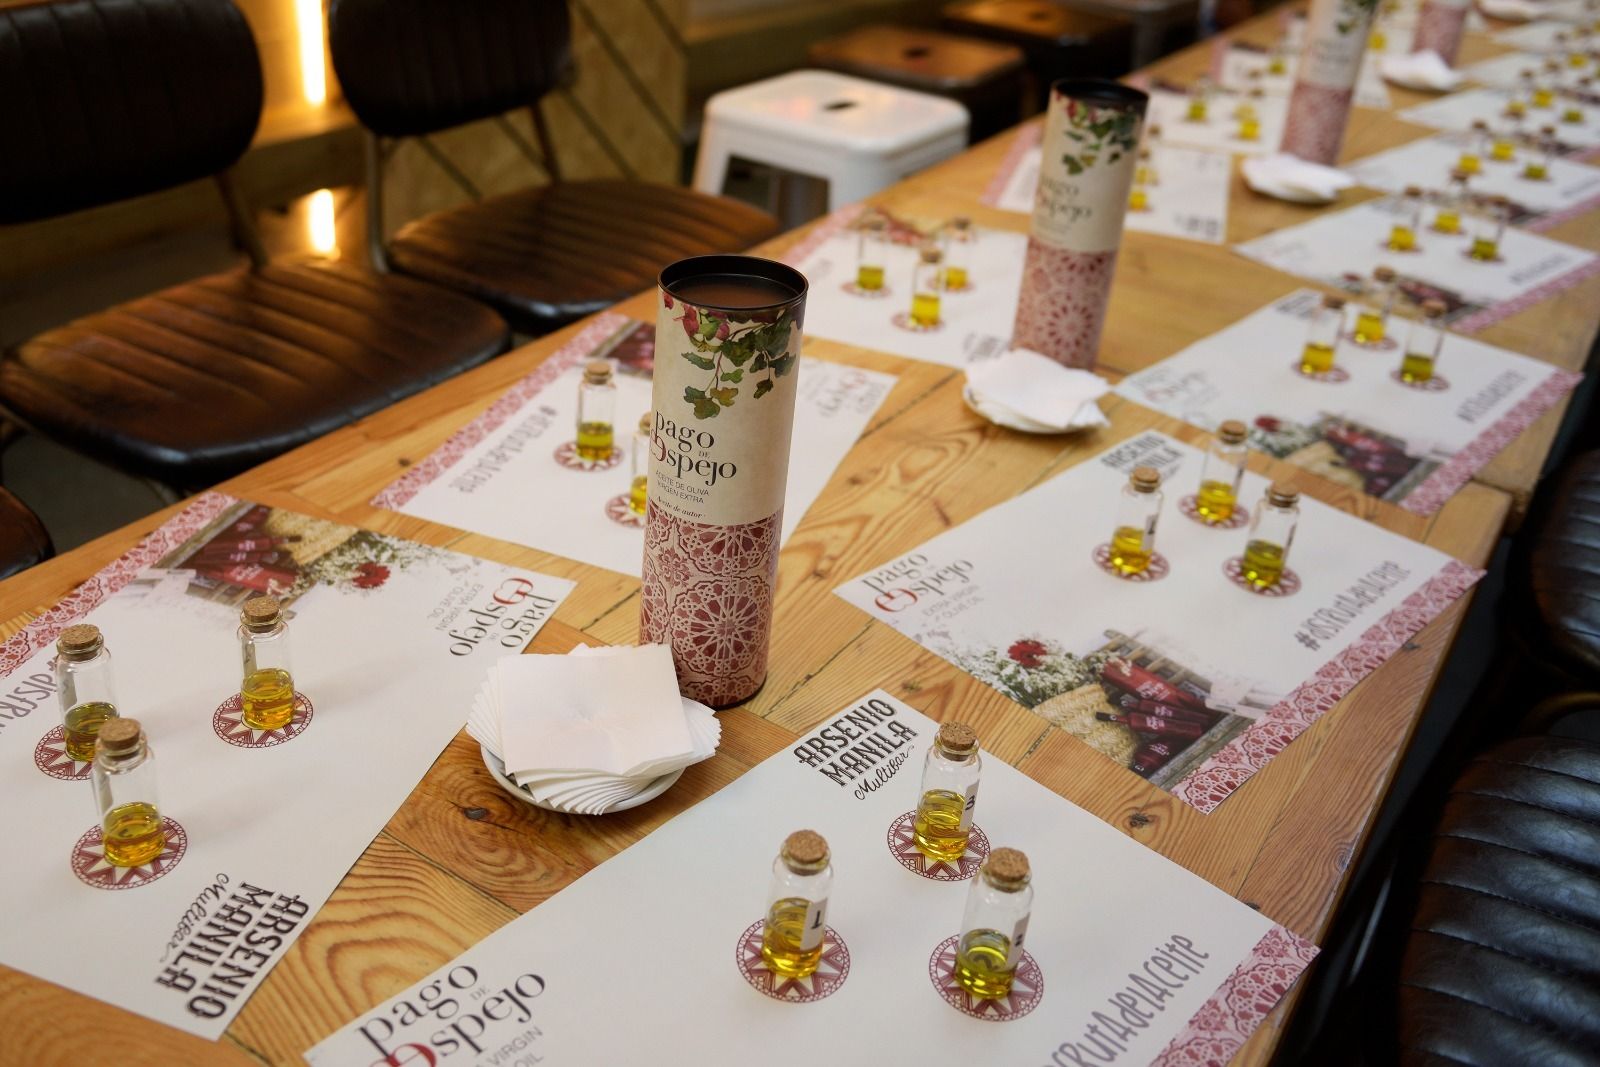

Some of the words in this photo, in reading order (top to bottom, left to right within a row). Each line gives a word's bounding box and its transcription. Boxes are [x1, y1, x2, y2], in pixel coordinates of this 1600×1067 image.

[656, 410, 715, 453] pago
[680, 490, 704, 504] EXTRA
[686, 485, 710, 497] OLIVA
[862, 554, 928, 597] pago
[500, 592, 557, 648] pago
[794, 698, 896, 767] ARSENIO
[819, 720, 918, 787] MANILA
[854, 745, 915, 800] Multibar
[155, 882, 275, 993] MANILA
[159, 873, 230, 963] Multibar
[187, 894, 309, 1019] ARSENIO
[356, 965, 479, 1059] pago
[470, 986, 491, 1000] DE
[486, 1026, 543, 1066] VIRGIN
